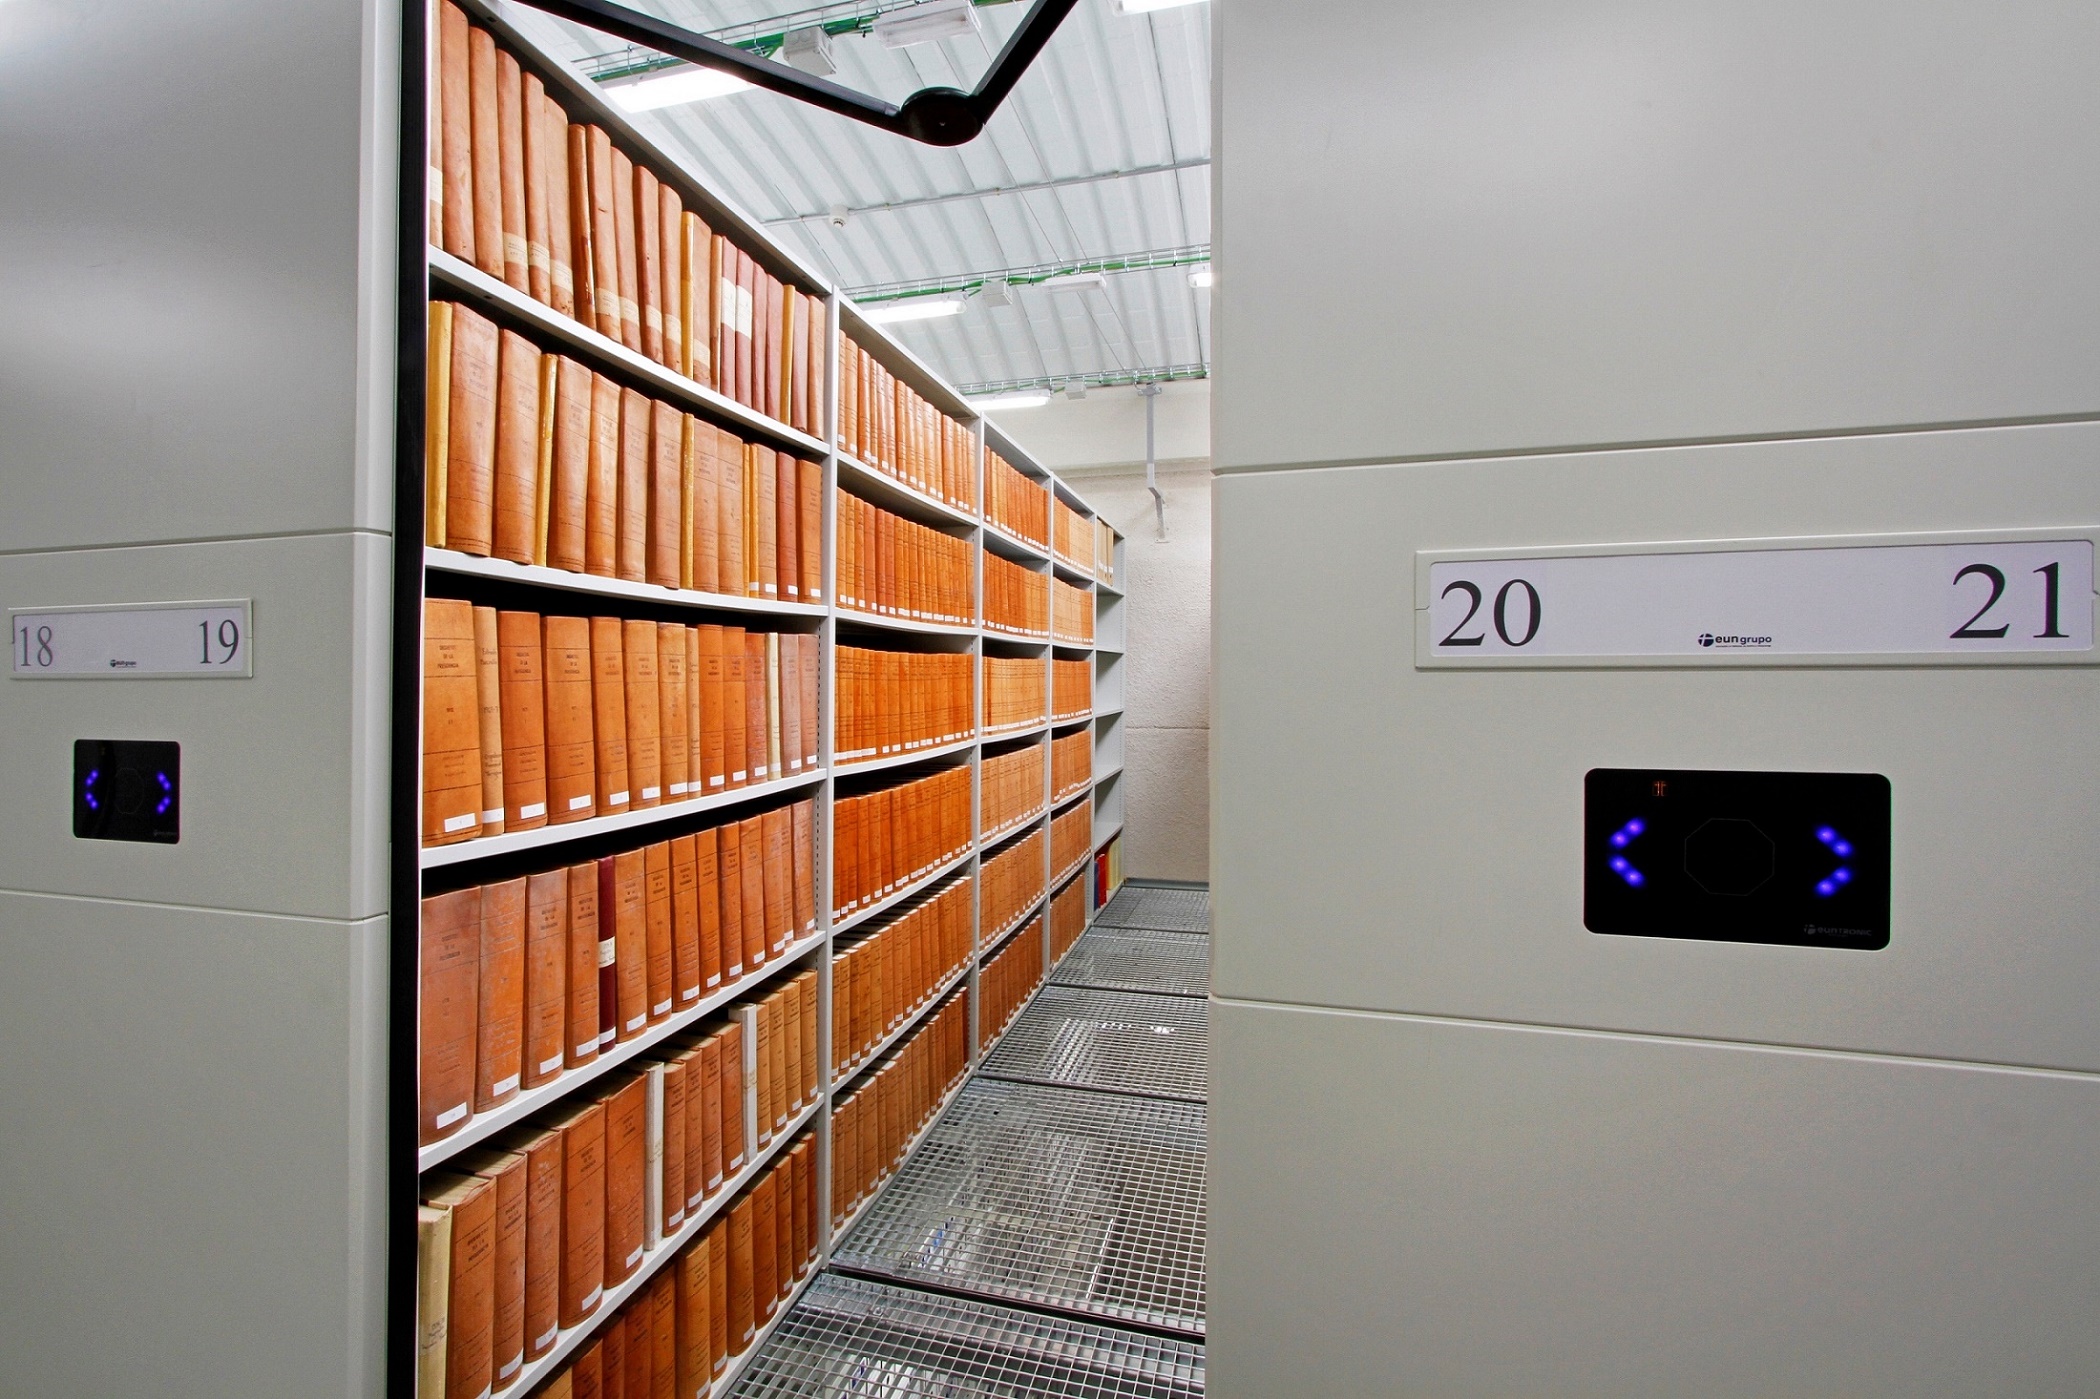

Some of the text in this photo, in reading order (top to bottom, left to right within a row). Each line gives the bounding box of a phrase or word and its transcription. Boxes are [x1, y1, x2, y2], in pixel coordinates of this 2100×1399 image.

[1440, 579, 1542, 646] 20
[1949, 562, 2069, 639] 21
[20, 626, 53, 667] 18
[199, 619, 239, 665] 19
[1715, 635, 1772, 645] eun grupo
